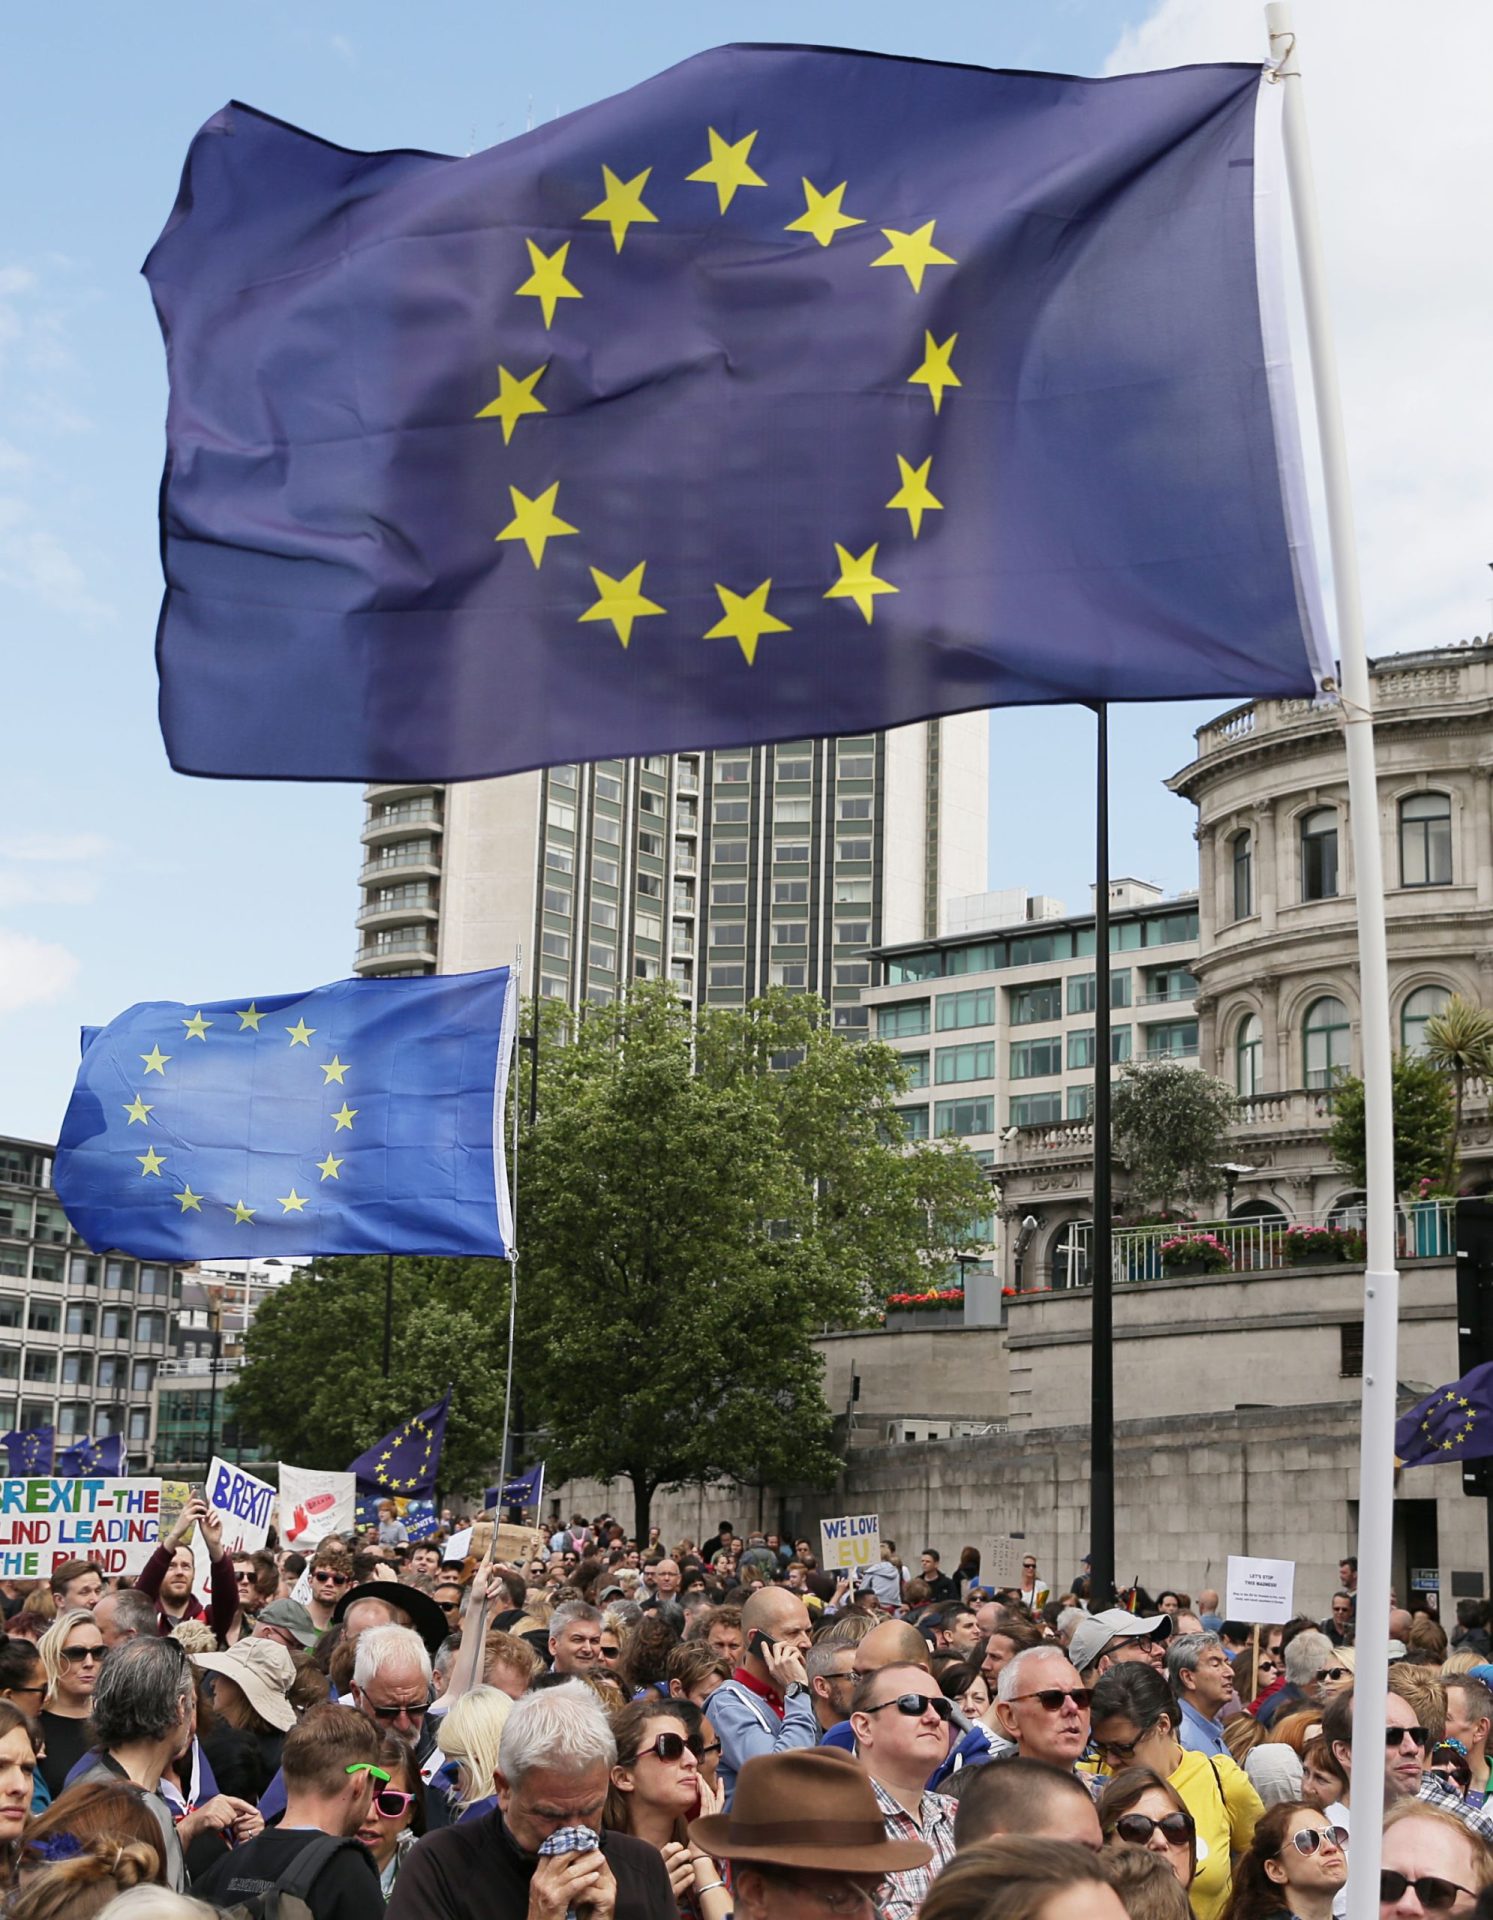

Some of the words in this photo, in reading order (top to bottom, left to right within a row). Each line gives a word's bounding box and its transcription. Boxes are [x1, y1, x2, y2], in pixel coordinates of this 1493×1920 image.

[0, 1480, 159, 1513] REXIT-THE
[212, 1465, 276, 1529] BREXIT
[58, 1519, 159, 1543] LEADING
[823, 1520, 847, 1539] WE
[850, 1516, 878, 1536] LOVE
[0, 1552, 39, 1575] HE
[838, 1539, 869, 1567] EU
